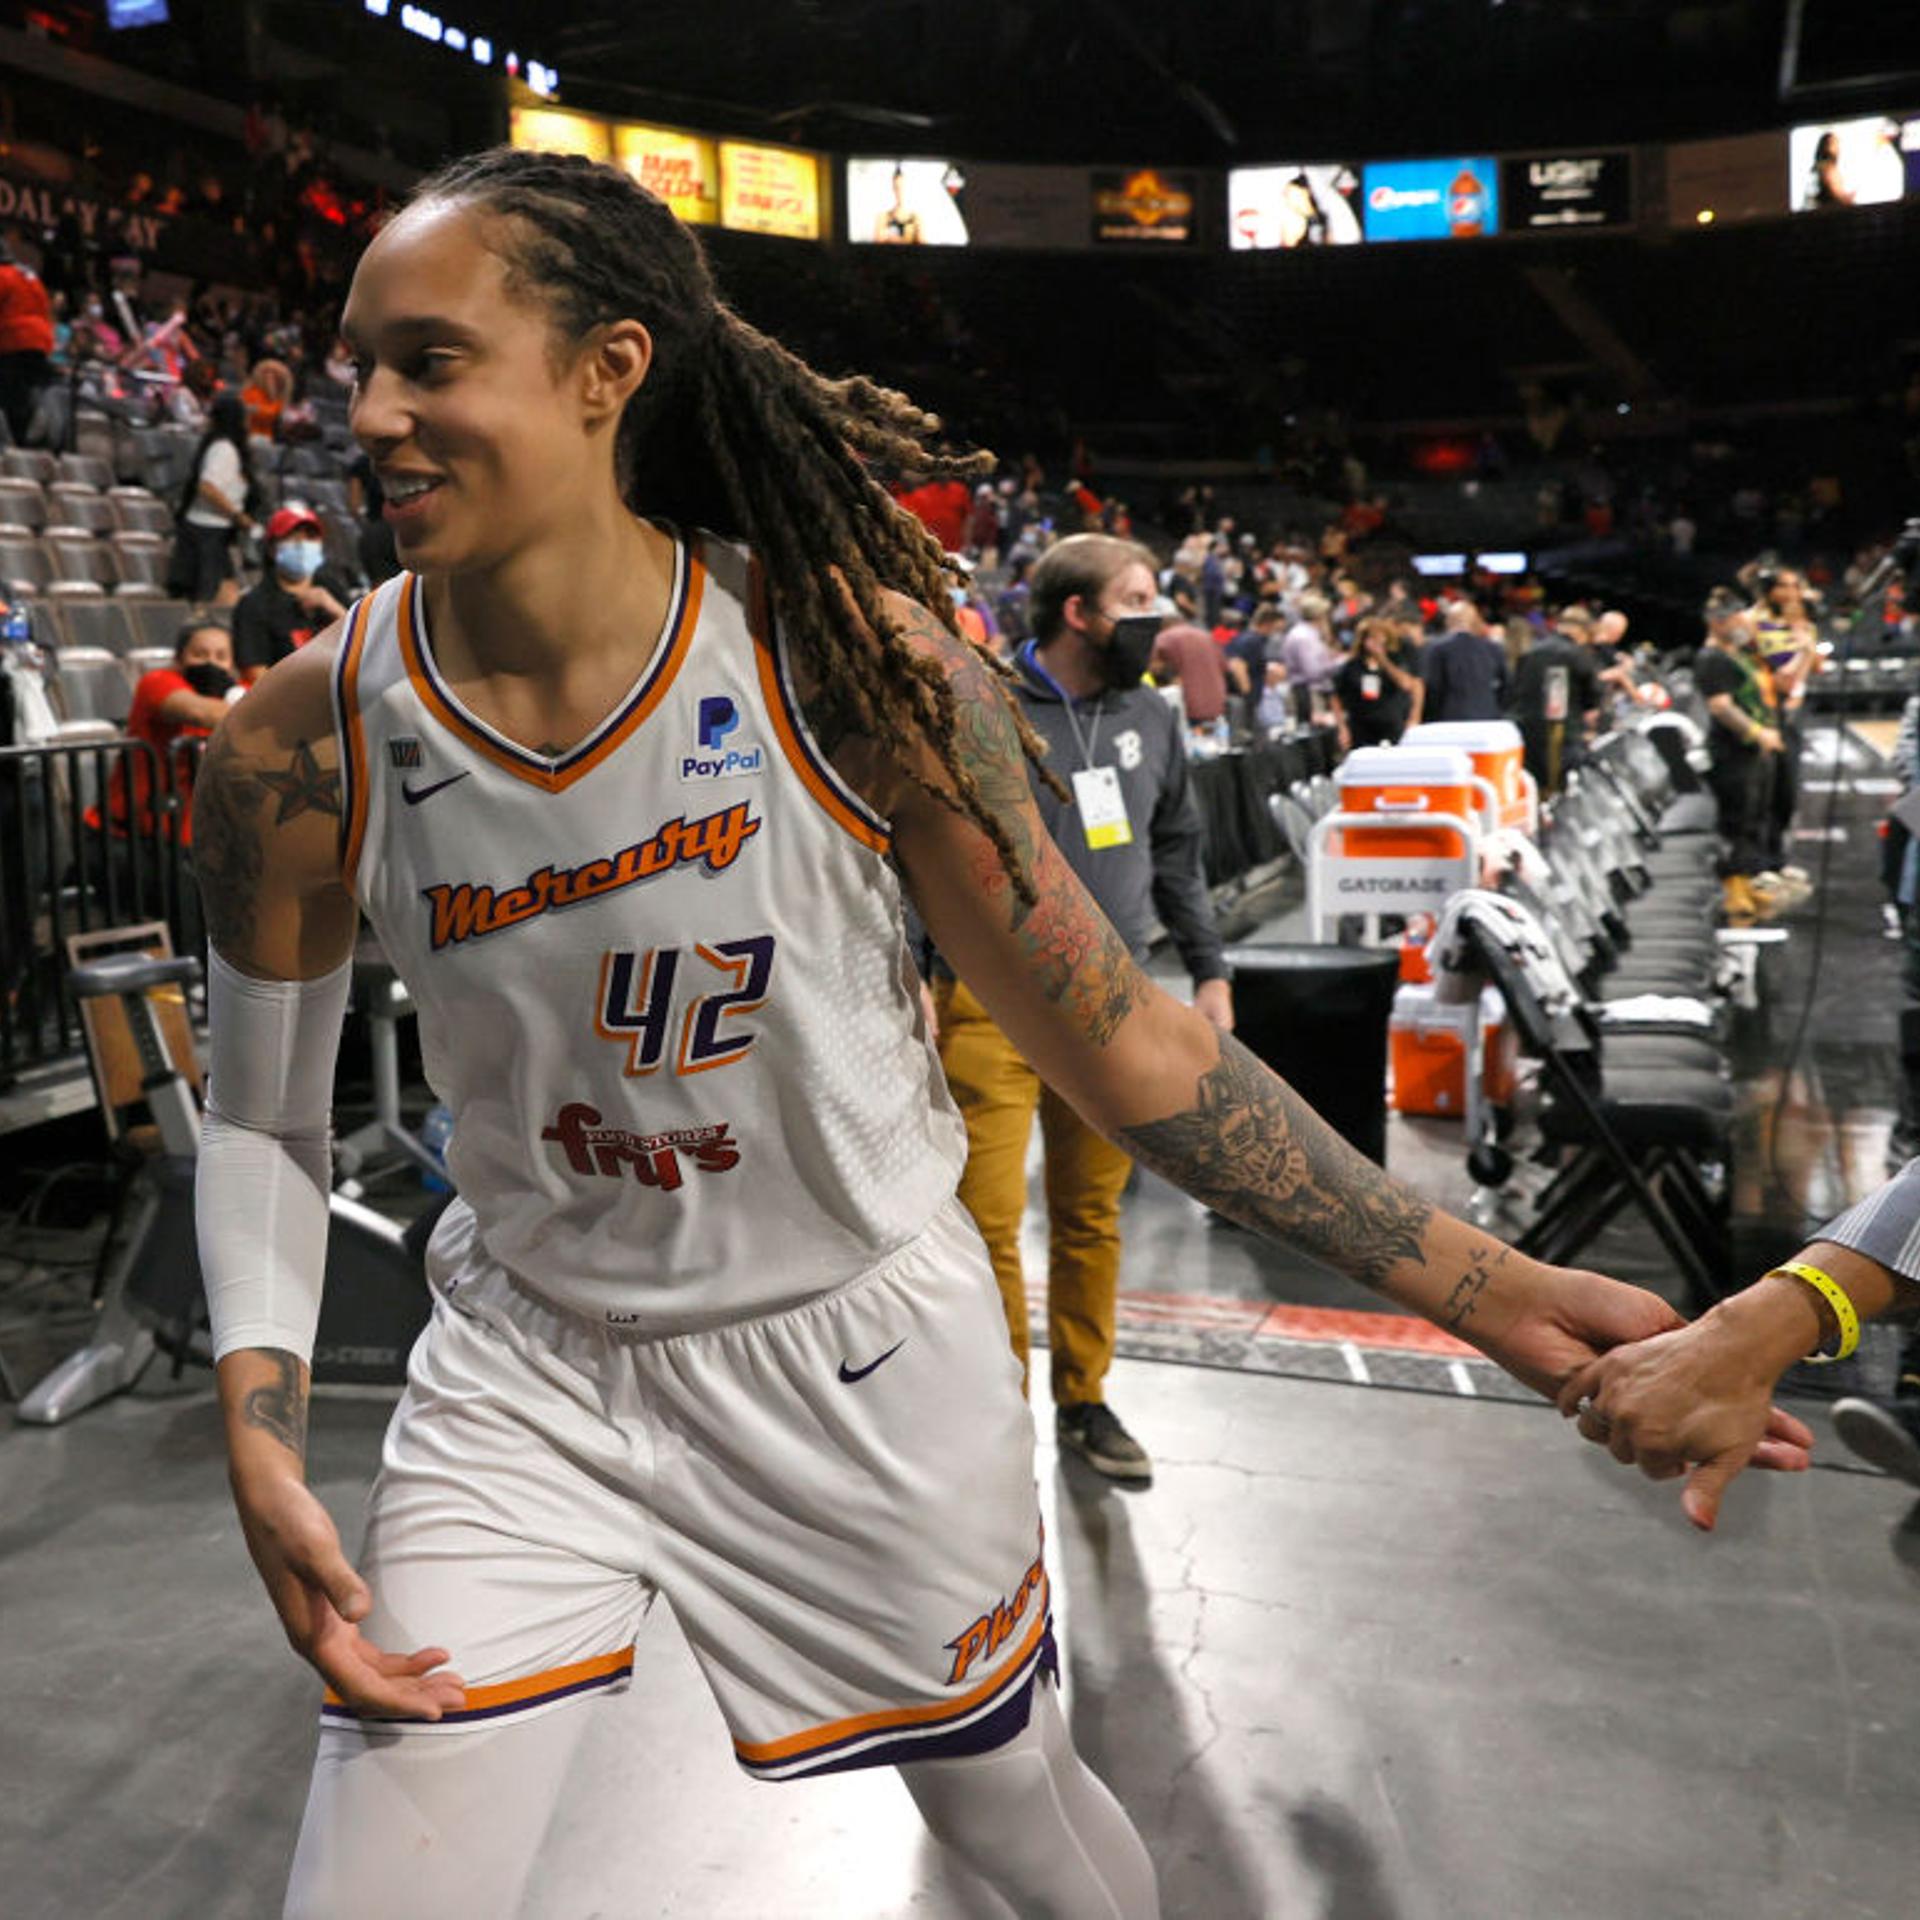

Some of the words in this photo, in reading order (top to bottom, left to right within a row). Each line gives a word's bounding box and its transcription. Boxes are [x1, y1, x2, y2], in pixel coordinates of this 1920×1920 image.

[683, 748, 760, 778] PayPal
[423, 800, 761, 951] Mercury
[1338, 877, 1444, 894] GATORADE
[594, 936, 775, 1077] 42
